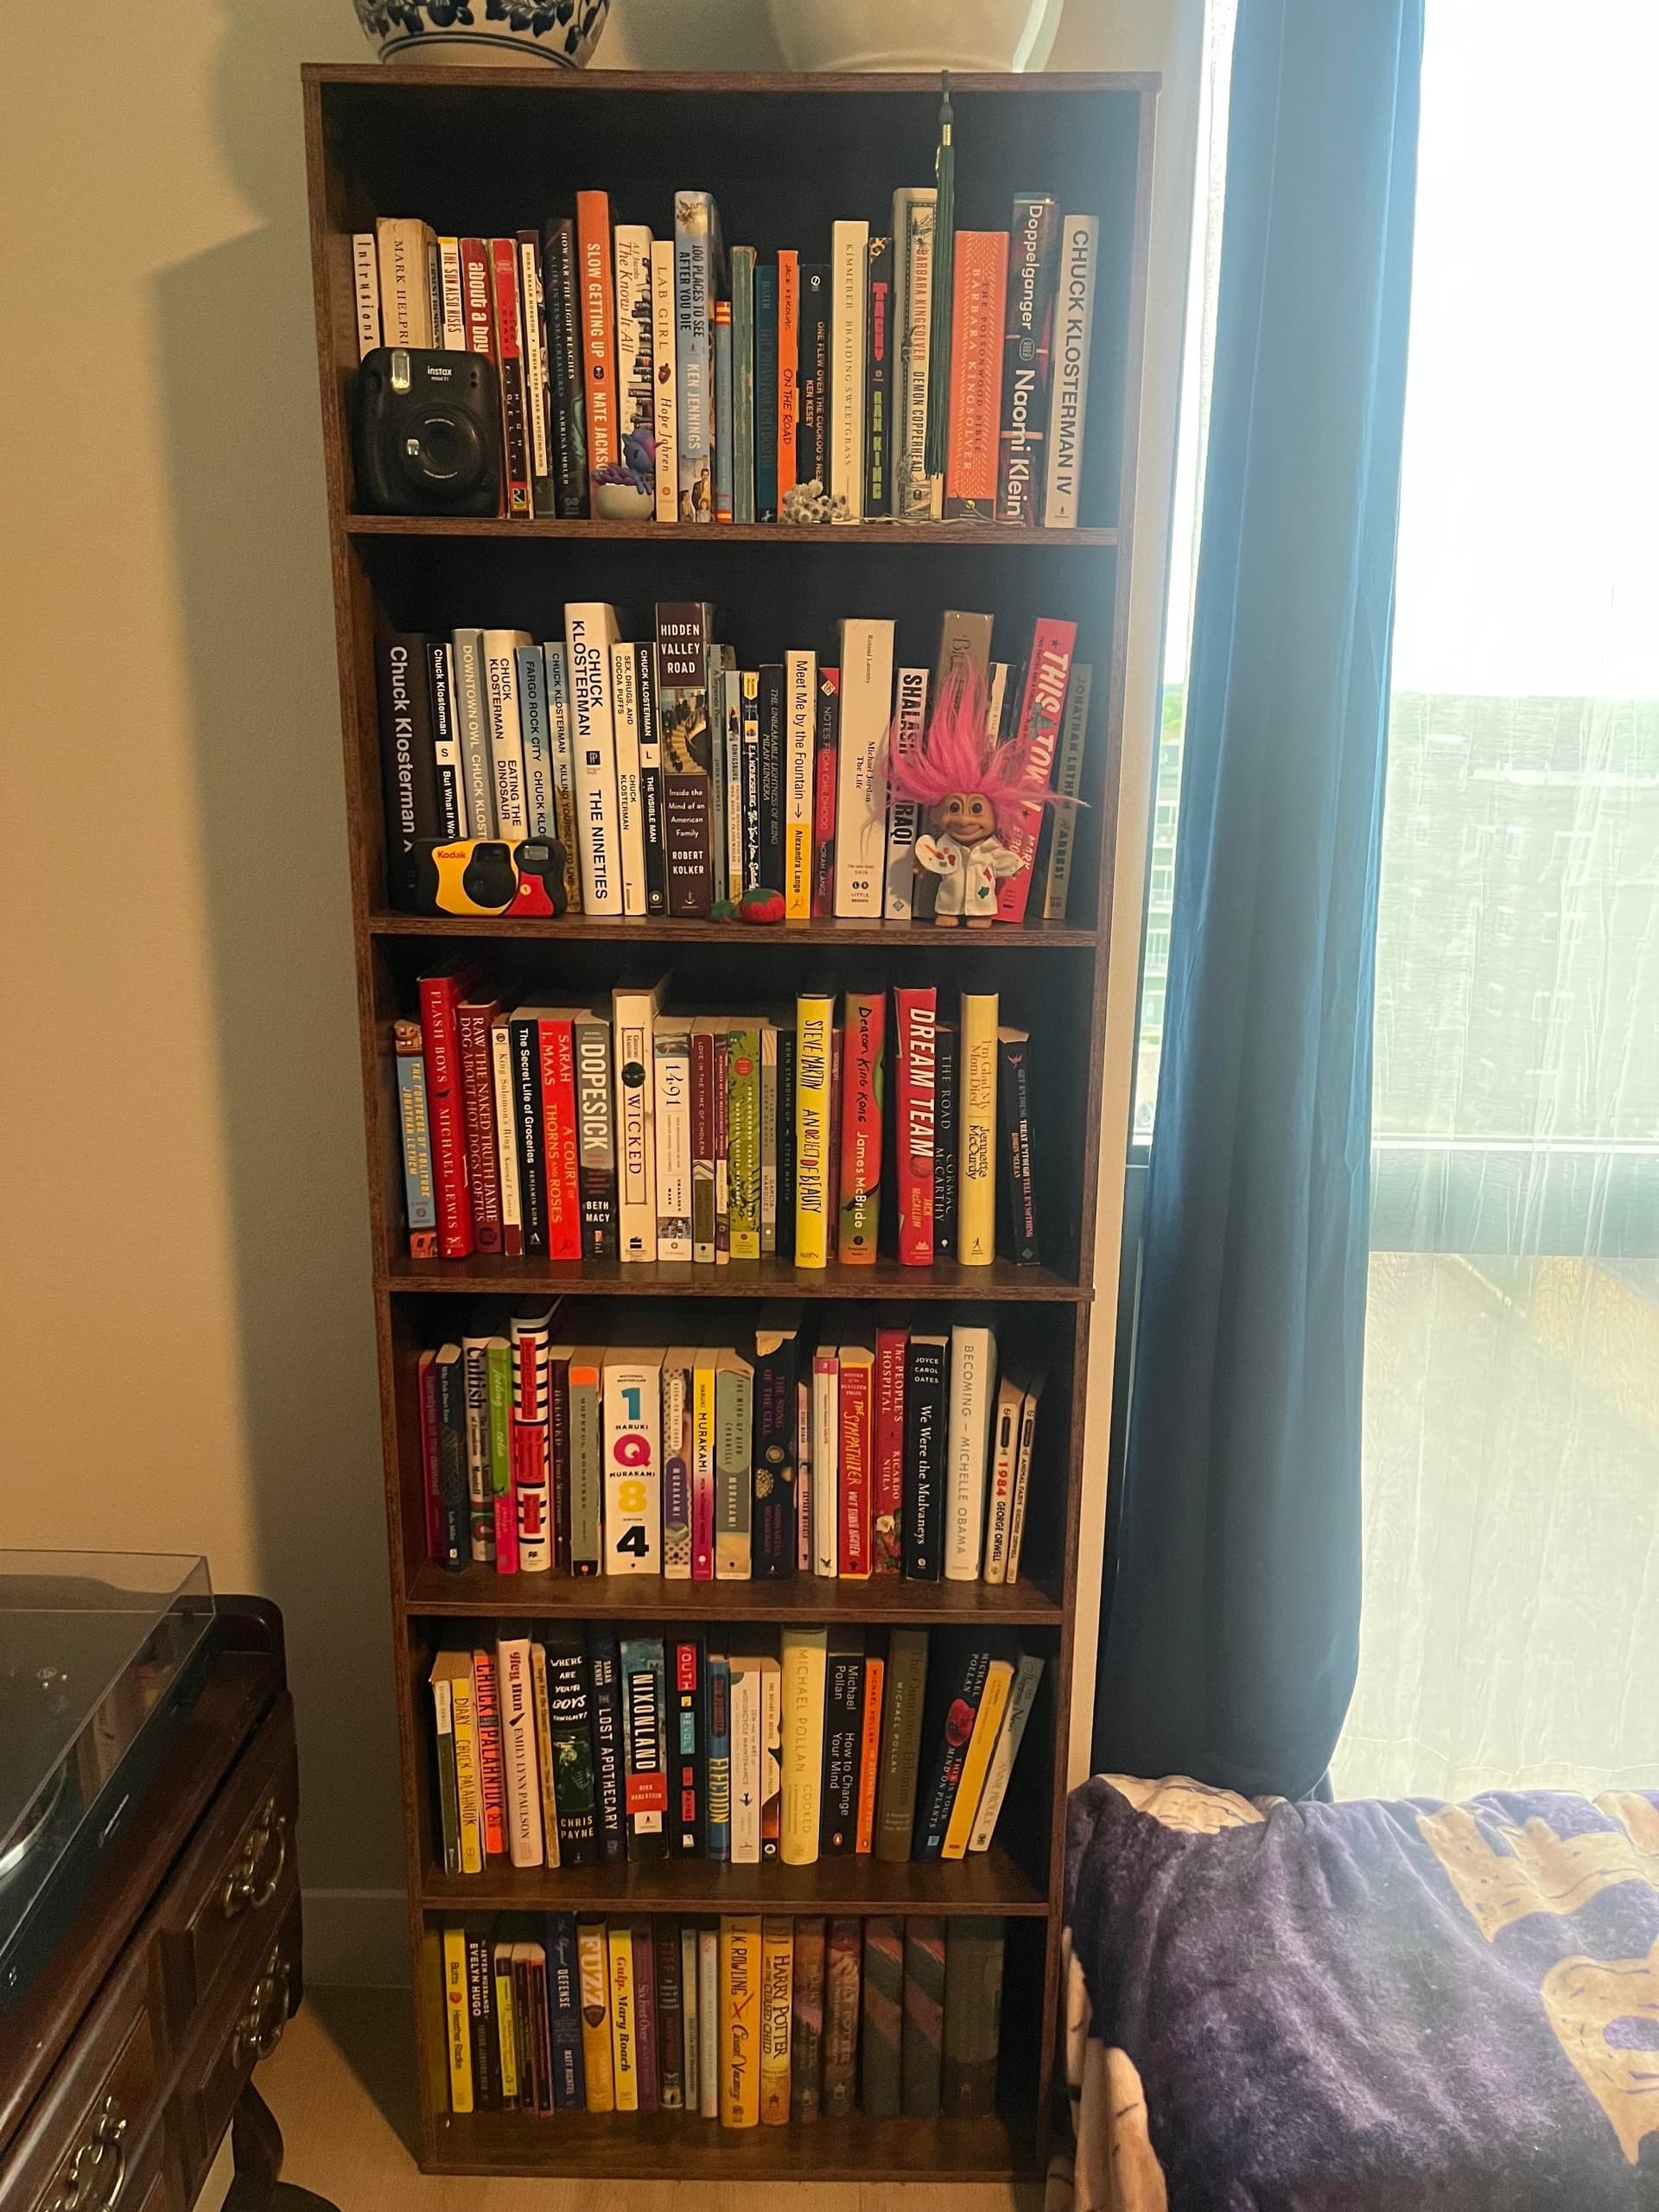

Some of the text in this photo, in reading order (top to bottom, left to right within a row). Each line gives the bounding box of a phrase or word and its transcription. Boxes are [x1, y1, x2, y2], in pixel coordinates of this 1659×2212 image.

[358, 242, 374, 341] Intrusions
[394, 241, 406, 283] MARK
[679, 251, 692, 332] AFTER YOU DIE
[692, 245, 706, 338] 100 PLACES TO SEE
[1020, 204, 1044, 329] Doppelganger
[588, 243, 605, 358] SLOW GETTING UP
[658, 266, 669, 350] LAB GIRL
[427, 365, 452, 376] instax
[911, 249, 928, 473] BARBARA KINGSOLVER DEMON COPPERHEAD
[1058, 230, 1089, 495] CHUCK KLOSTERMAN IV
[594, 392, 607, 421] NATE
[658, 398, 672, 472] Hope Jahren
[687, 364, 702, 449] KEN JENNINGS
[1010, 370, 1035, 450] Naomi
[1006, 458, 1030, 516] Klein
[661, 625, 701, 637] HIDDEN
[661, 643, 701, 656] VALLEY
[489, 659, 505, 739] KLOSTERMAN
[500, 658, 512, 700] CHUCK
[572, 620, 591, 736] KLOSTERMAN
[588, 649, 603, 708] CHUCK
[668, 662, 696, 674] ROAD
[390, 646, 416, 834] Chuck Klosterman
[792, 661, 808, 800] Meet Me by the Fountain
[498, 760, 511, 820] DINOSAUR
[508, 760, 521, 827] EATING THE
[589, 790, 607, 899] THE NINETIES
[672, 851, 704, 860] ROBERT
[676, 830, 699, 838] Family
[673, 865, 704, 874] KOLKER
[430, 991, 448, 1083] FLASH BOYS
[543, 1045, 556, 1086] MAAS
[558, 1035, 571, 1082] SARAH
[800, 1020, 825, 1090] STEVE MARTIN
[855, 1007, 872, 1123] Deacon King Kong
[518, 1028, 536, 1164] The Secret Life of Groceries
[581, 1044, 608, 1150] DOPESICK
[661, 1065, 684, 1106] 1491
[909, 1008, 935, 1157] DREAM TEAM
[546, 1103, 563, 1224] THORNS ROSES
[563, 1127, 576, 1188] A COURT
[627, 1094, 642, 1174] WICKED
[799, 1109, 822, 1213] AN OBJECT OF BEAUTY
[439, 1109, 457, 1229] MICHAEL LEWIS
[854, 1131, 869, 1228] James McBride
[586, 1201, 609, 1210] BETH
[586, 1213, 610, 1222] MACY
[621, 1387, 640, 1421] 1
[854, 1400, 865, 1416] THE
[613, 1433, 652, 1467] Q
[698, 1412, 708, 1472] MURAKAMI
[844, 1411, 863, 1486] SYMPATHIZER
[913, 1405, 932, 1546] We Were the Mulvaneys
[957, 1344, 975, 1554] BECOMING MICHELLE OBAMA
[618, 1480, 647, 1513] 8
[992, 1462, 1008, 1562] 1984 GEORGE ORWELL
[616, 1526, 650, 1558] 4
[550, 1656, 582, 1667] WHERE
[555, 1684, 581, 1694] YOUR
[681, 1644, 693, 1690] YOUTH
[834, 1665, 846, 1700] Pollan
[846, 1665, 859, 1711] Michael
[552, 1694, 587, 1709] BOYS
[553, 1712, 588, 1721] TONIGHT?
[632, 1674, 657, 1770] NIXONLAND
[795, 1648, 809, 1772] MICHAEL POLLAN
[476, 1664, 504, 1810] CHUCK PALAHNIUK
[599, 1708, 619, 1829] LOST APOTHECARY
[830, 1732, 843, 1789] Your Mind
[709, 1758, 729, 1822] ELECTION
[839, 1732, 855, 1816] How to Change
[561, 1815, 593, 1827] CHRIS
[561, 1827, 594, 1840] PAYNE
[451, 1961, 460, 1985] Butts
[470, 1943, 481, 2017] EVELYN HUGO
[557, 1968, 570, 2007] DEFENSE
[581, 1934, 604, 2007] FUZZ
[731, 1948, 748, 1996] ROWLING
[615, 1956, 631, 2072] Gulp. Mary Roach
[772, 1955, 791, 2061] HARRY POTTER
